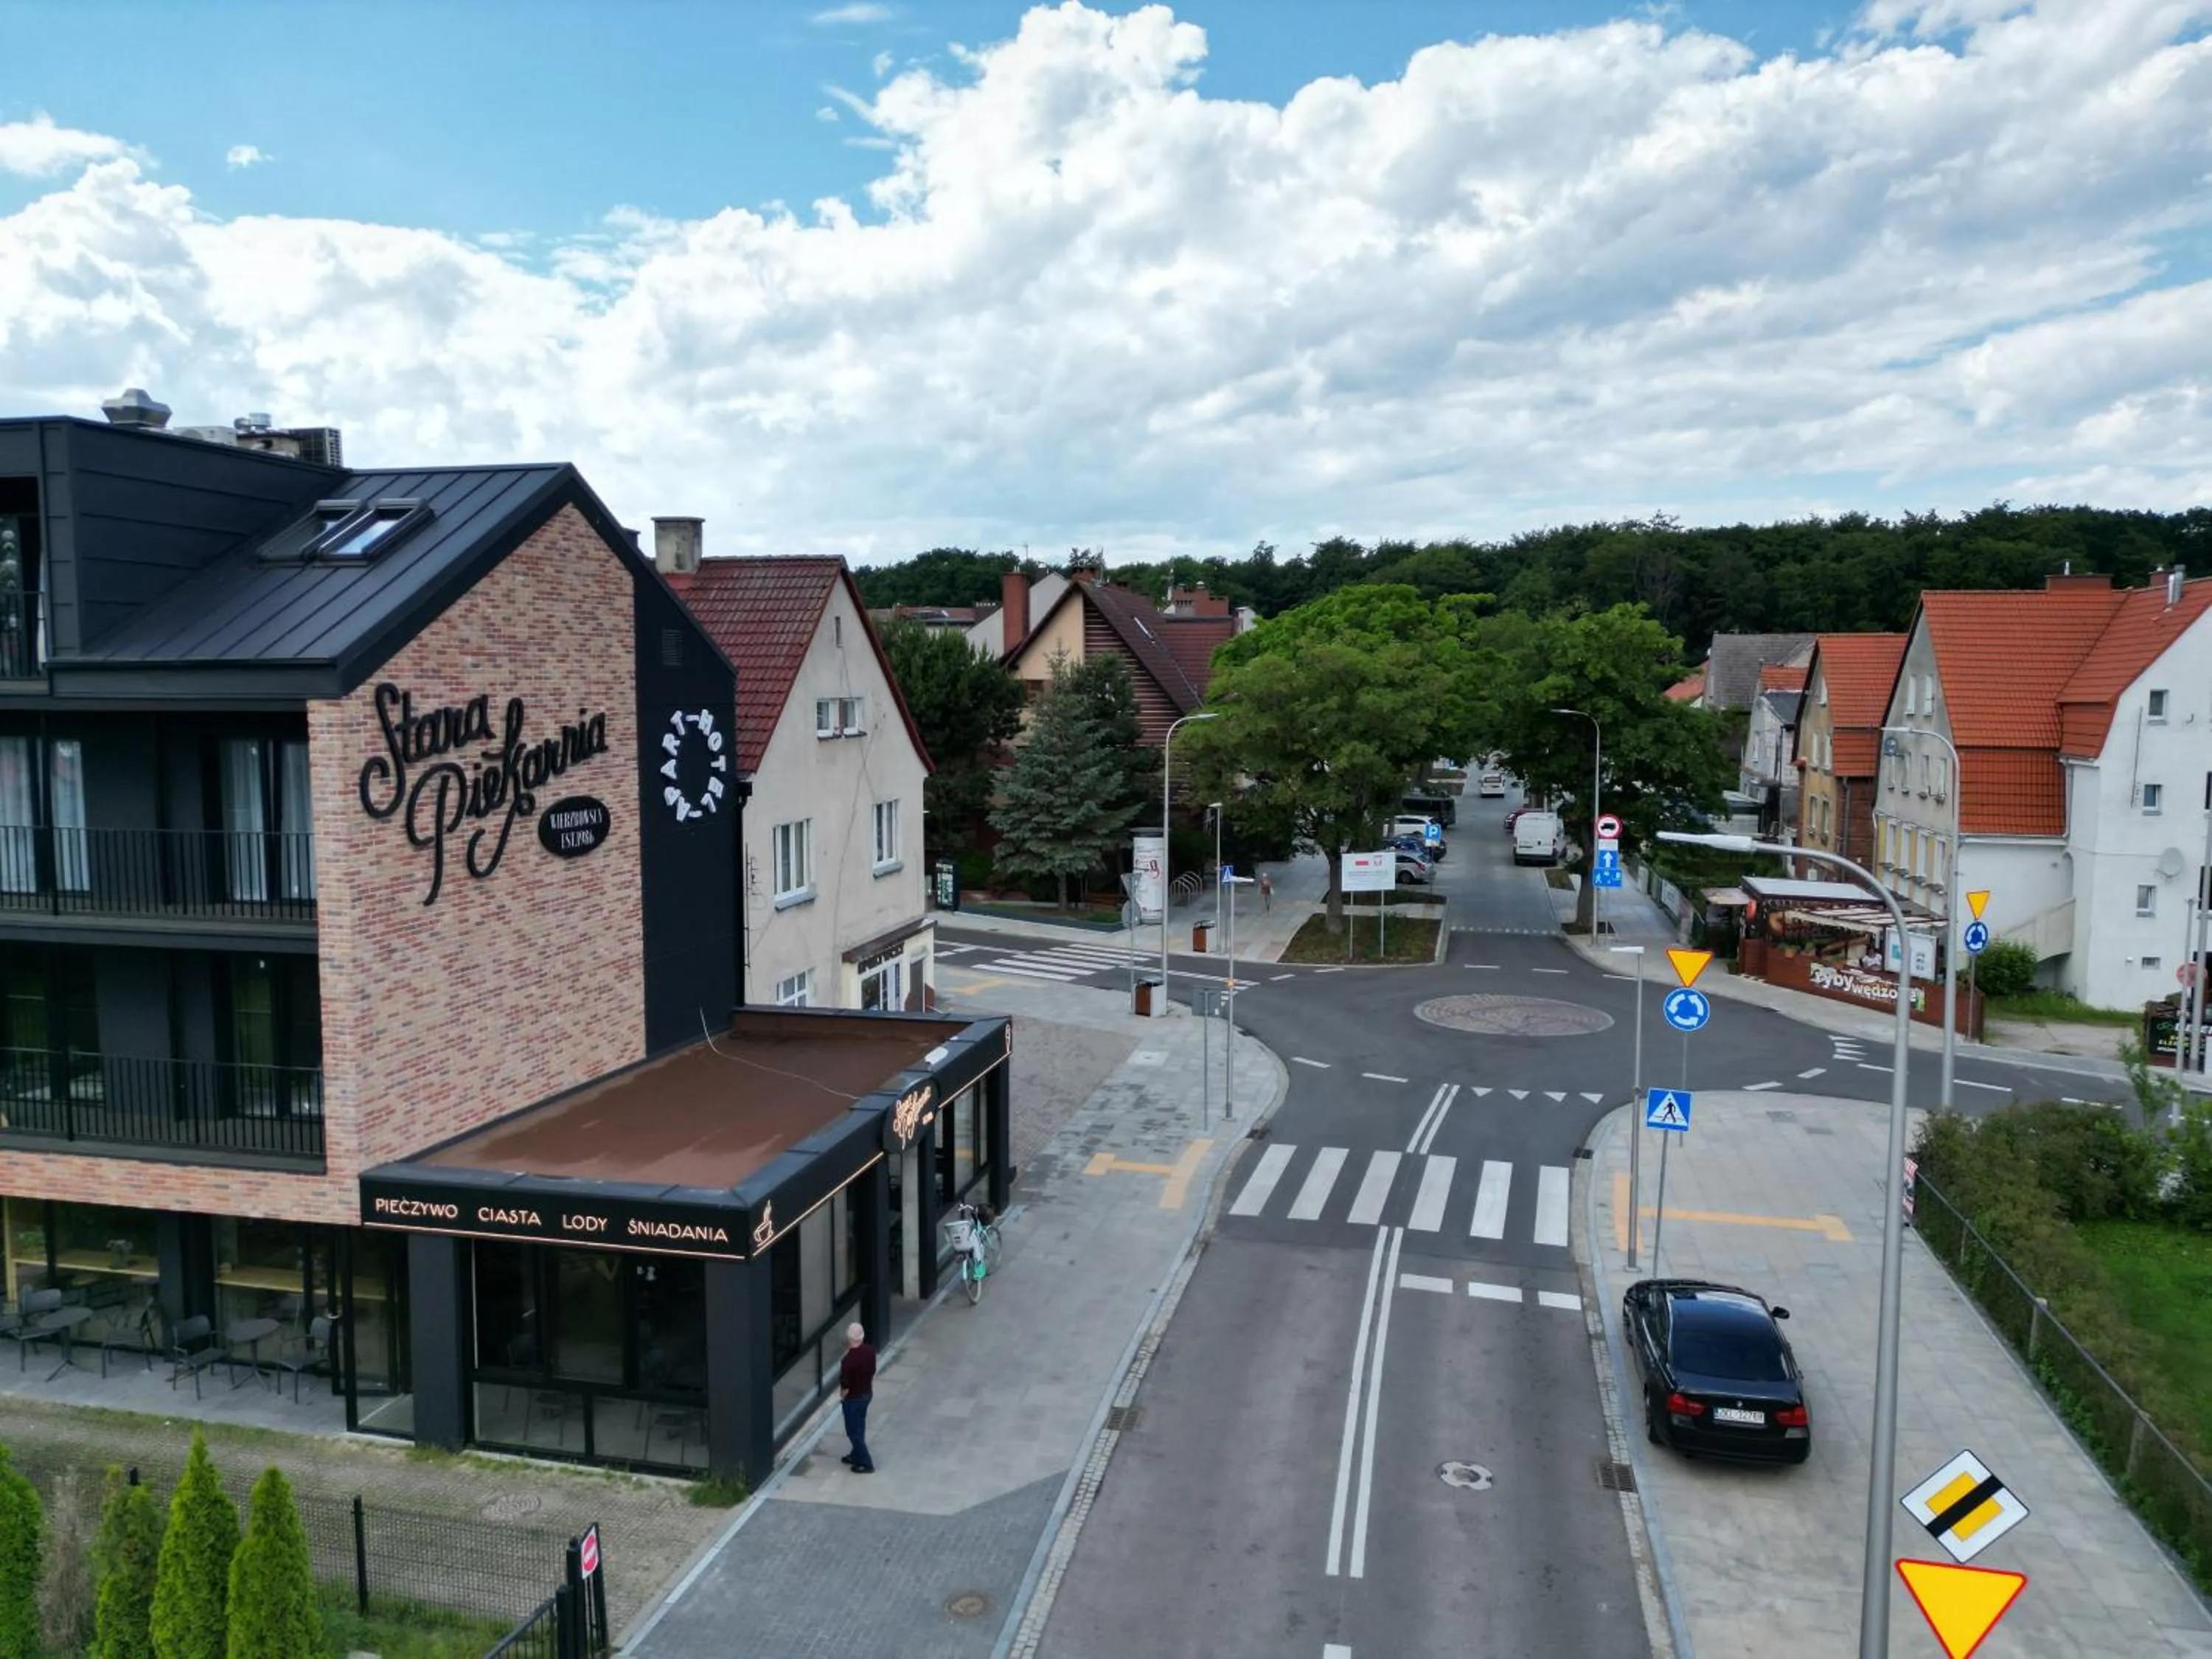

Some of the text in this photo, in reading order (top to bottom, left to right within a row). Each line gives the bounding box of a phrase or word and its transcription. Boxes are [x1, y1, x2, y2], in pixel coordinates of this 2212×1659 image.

[360, 683, 497, 819] Stara
[406, 698, 608, 906] Piekarnia
[1851, 981, 1917, 1003] wędzoe
[478, 1206, 542, 1226] CIASTA
[563, 1214, 608, 1232] LODY
[627, 1218, 728, 1242] ŚNIADANIA
